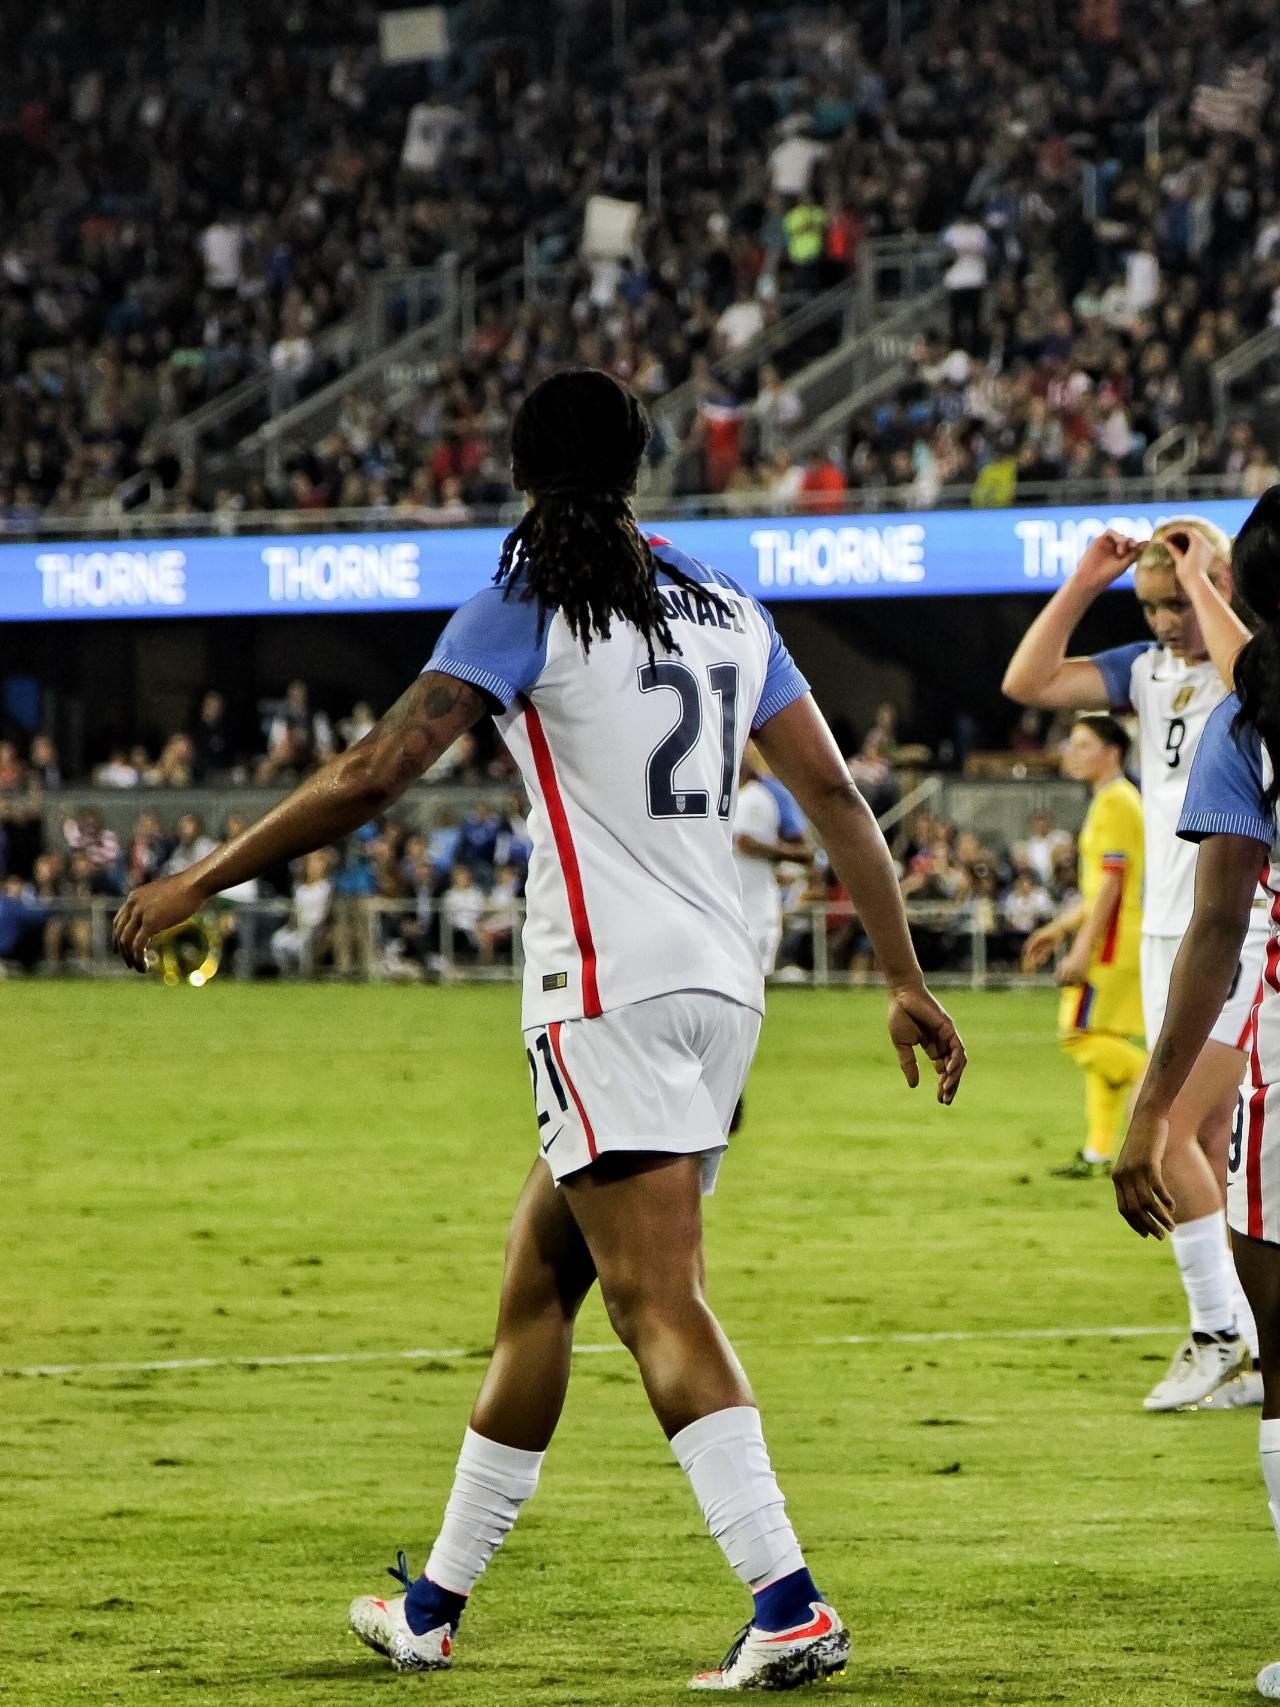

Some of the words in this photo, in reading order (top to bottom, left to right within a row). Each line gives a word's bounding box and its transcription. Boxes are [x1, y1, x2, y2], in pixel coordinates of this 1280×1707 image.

[35, 550, 186, 608] THORNE
[261, 543, 419, 600] THORNE
[750, 525, 925, 586] THORNE
[637, 660, 740, 820] 21
[1166, 716, 1186, 768] 9
